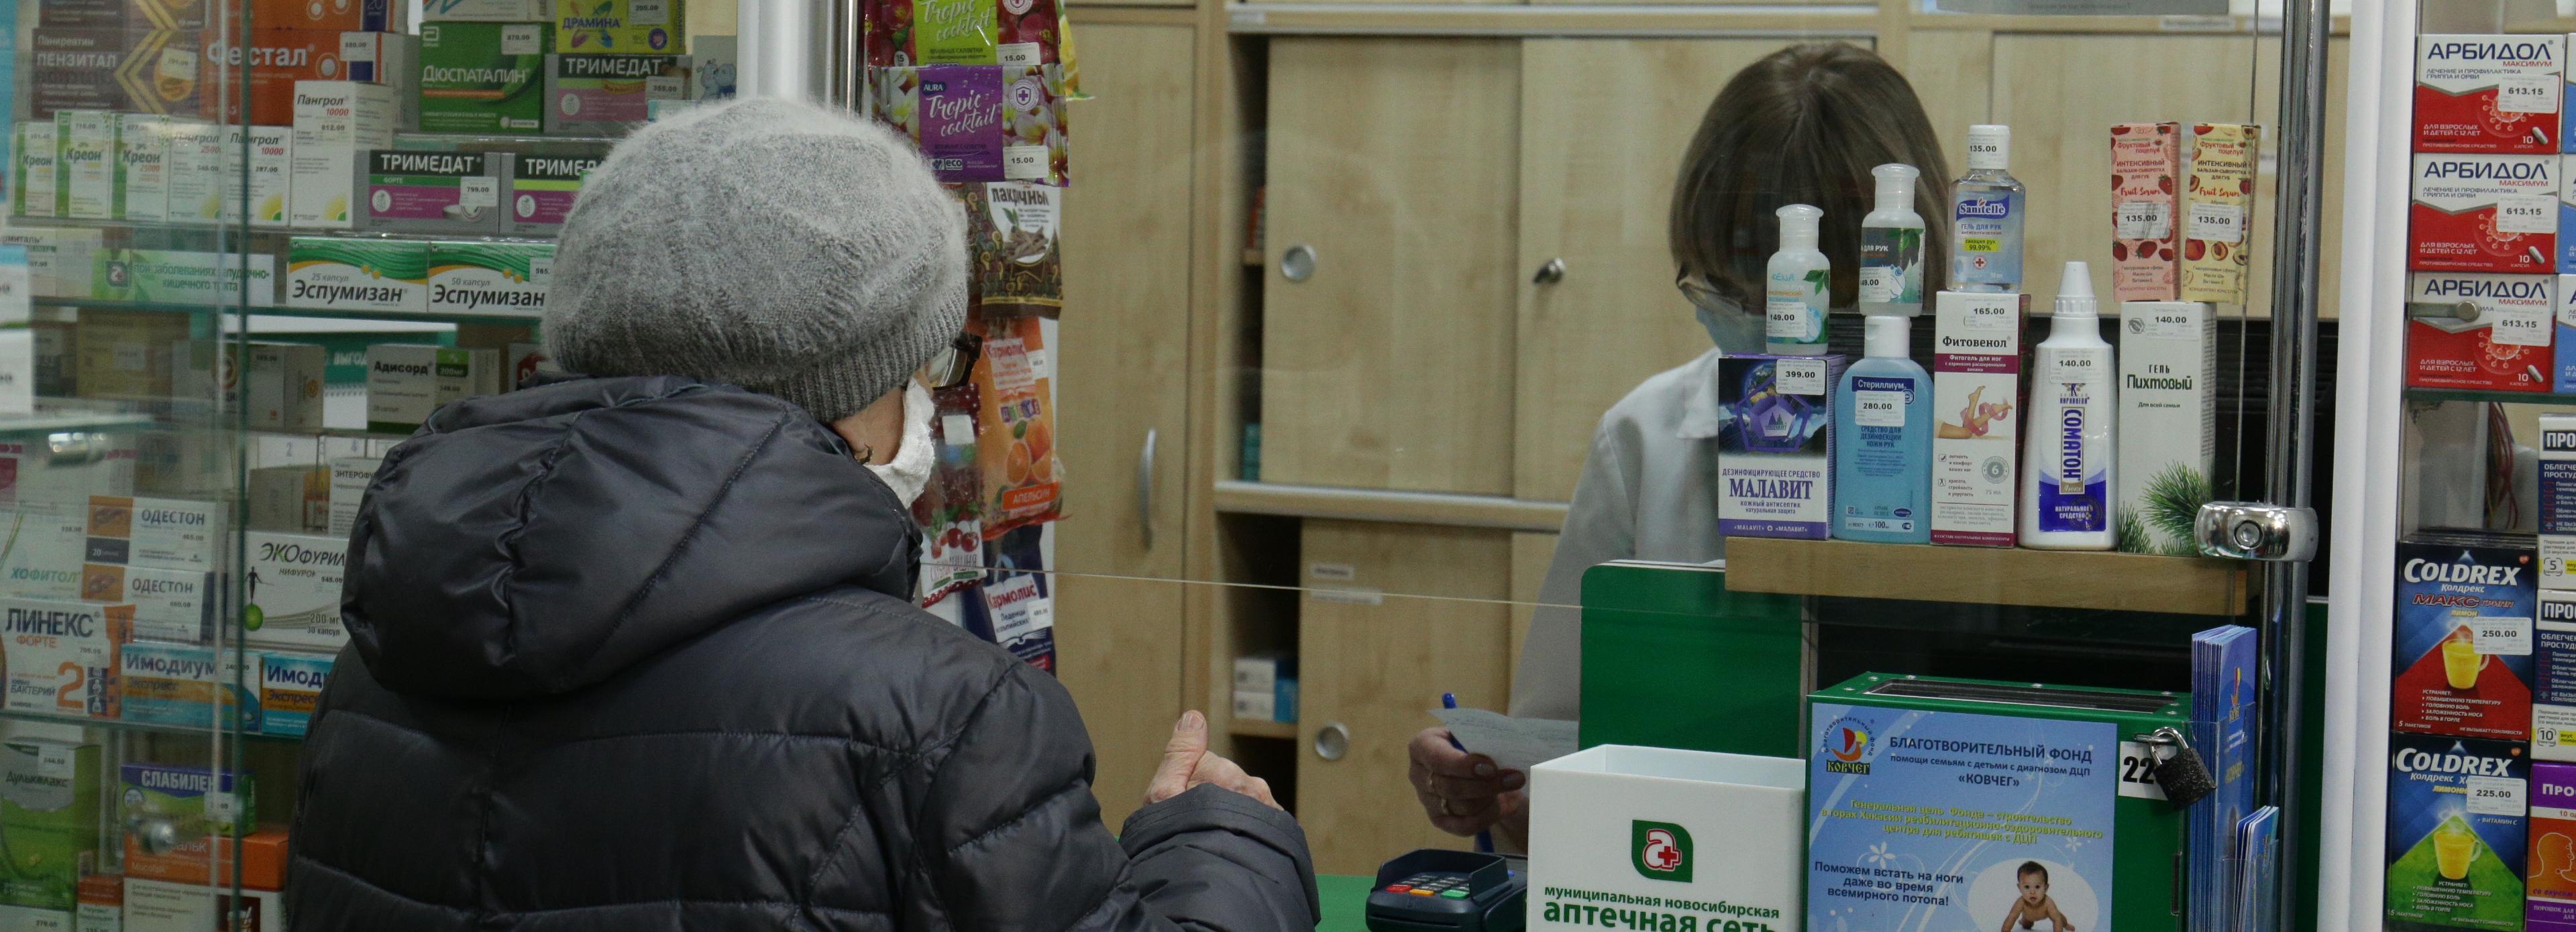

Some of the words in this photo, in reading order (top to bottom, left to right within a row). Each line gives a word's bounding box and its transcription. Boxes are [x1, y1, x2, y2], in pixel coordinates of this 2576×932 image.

[563, 17, 620, 30] ДРАМИНА
[207, 40, 308, 66] Фестал
[2427, 43, 2551, 60] АРБИДОЛ
[37, 54, 116, 67] ПЕНЗИТАЛ
[566, 58, 661, 76] ТРИМЕДАТ
[422, 65, 526, 83] ДЮСПАТАЛИН
[923, 82, 944, 93] AURA
[2508, 87, 2544, 96] 613.15
[297, 95, 343, 107] Пангрол
[926, 90, 981, 119] Tropic
[326, 108, 350, 116] 10000
[941, 103, 997, 137] cocktail
[2522, 135, 2534, 143] 10
[22, 155, 52, 168] Креон
[66, 148, 101, 163] Креон
[123, 150, 160, 166] Креон
[380, 154, 475, 174] ТРИМЕДАТ
[2116, 159, 2165, 167] ИНТЕНСИВНЫЙ
[2197, 160, 2247, 168] ИНТЕНСИВНЫЙ
[2424, 161, 2548, 180] АРБИДОЛ
[2121, 186, 2137, 196] Fruit
[2139, 186, 2161, 196] Serum
[2199, 186, 2217, 196] Fruit
[2218, 187, 2240, 198] Serum
[1959, 203, 2006, 215] Sanitelle
[2506, 208, 2542, 216] 613.15
[2198, 216, 2231, 225] 135.00
[2519, 255, 2530, 264] 10
[311, 273, 321, 281] 25
[451, 277, 461, 286] 50
[292, 280, 402, 304] Эспумизан
[2424, 279, 2546, 299] АРБИДОЛ
[432, 284, 545, 309] Эспумизан
[2498, 298, 2547, 306] МАКСИМУМ
[2154, 316, 2187, 324] 140.00
[2502, 320, 2537, 328] 613.15
[1942, 336, 2007, 348] Фитовенол
[373, 360, 428, 376] Адисорд
[2059, 359, 2091, 367] 140.00
[2149, 364, 2171, 374] ГЕЛЬ
[1784, 371, 1816, 379] 399.00
[2518, 373, 2529, 382] 10
[1858, 379, 1904, 390] Стериллиум
[2127, 374, 2193, 391] Пихтовый
[1889, 426, 1902, 434] ДЛЯ
[1860, 433, 1902, 442] ДЕЗИНФЕКЦИИ
[2062, 409, 2083, 479] СОМАТОН
[1722, 468, 1787, 478] ДЕЗИНФИЦИРУЮЩЕЕ
[1729, 478, 1813, 500] МАЛАВИТ
[142, 508, 205, 526] ОДЕСТОН
[1874, 521, 1886, 530] 100
[93, 548, 101, 557] 20
[10, 568, 78, 583] ХОФИТОЛ
[2404, 559, 2522, 586] COLDREX
[132, 578, 193, 595] ОДЕСТОН
[2441, 583, 2485, 594] Колдрекс
[2412, 593, 2480, 608] МАКС
[5, 607, 93, 638] ЛИНЕКС
[310, 613, 327, 624] 200
[329, 615, 340, 626] мг
[2482, 630, 2518, 638] 250.00
[17, 634, 58, 649] ФОРТЕ
[11, 685, 56, 697] БАКТЕРИЙ
[1890, 736, 2045, 759] БЛАГОТВОРИТЕЛЬНЫЙ
[2049, 747, 2092, 764] ФОНД
[1890, 755, 1929, 765] помощи
[1930, 758, 1965, 767] семьям
[1974, 762, 2008, 770] детьми
[2017, 765, 2067, 775] диагнозом
[2069, 767, 2091, 776] ДЦП
[2396, 748, 2514, 777] COLDREX
[1959, 773, 2020, 788] «КОВЧЕГ»
[2410, 772, 2454, 783] Колдрекс
[2476, 789, 2511, 798] 225.00
[1851, 799, 1917, 813] Генеральная
[1919, 806, 1944, 815] цель
[1949, 807, 1984, 819] Фонда
[1996, 812, 2072, 826] строительство
[1830, 811, 1857, 819] горах
[1860, 810, 1902, 822] Хакасии
[1904, 817, 2103, 839] реабилитационно-оздоровительного
[1883, 825, 1920, 834] центра
[1922, 827, 1941, 836] для
[1945, 829, 2002, 842] ребятишек
[2012, 835, 2039, 845] ДЦП
[1815, 861, 1870, 875] Поможем
[1874, 869, 1914, 879] встать
[1917, 872, 1932, 881] на
[1935, 874, 1964, 884] ноги
[1843, 877, 1874, 887] даже
[1877, 880, 1892, 888] во
[1895, 882, 1933, 893] время
[1544, 885, 1661, 908] муниципальная
[1664, 897, 1780, 920] новосибирская
[1827, 887, 1899, 902] всемирного
[1902, 895, 1949, 907] потопа!
[1543, 900, 1697, 932] аптечная
